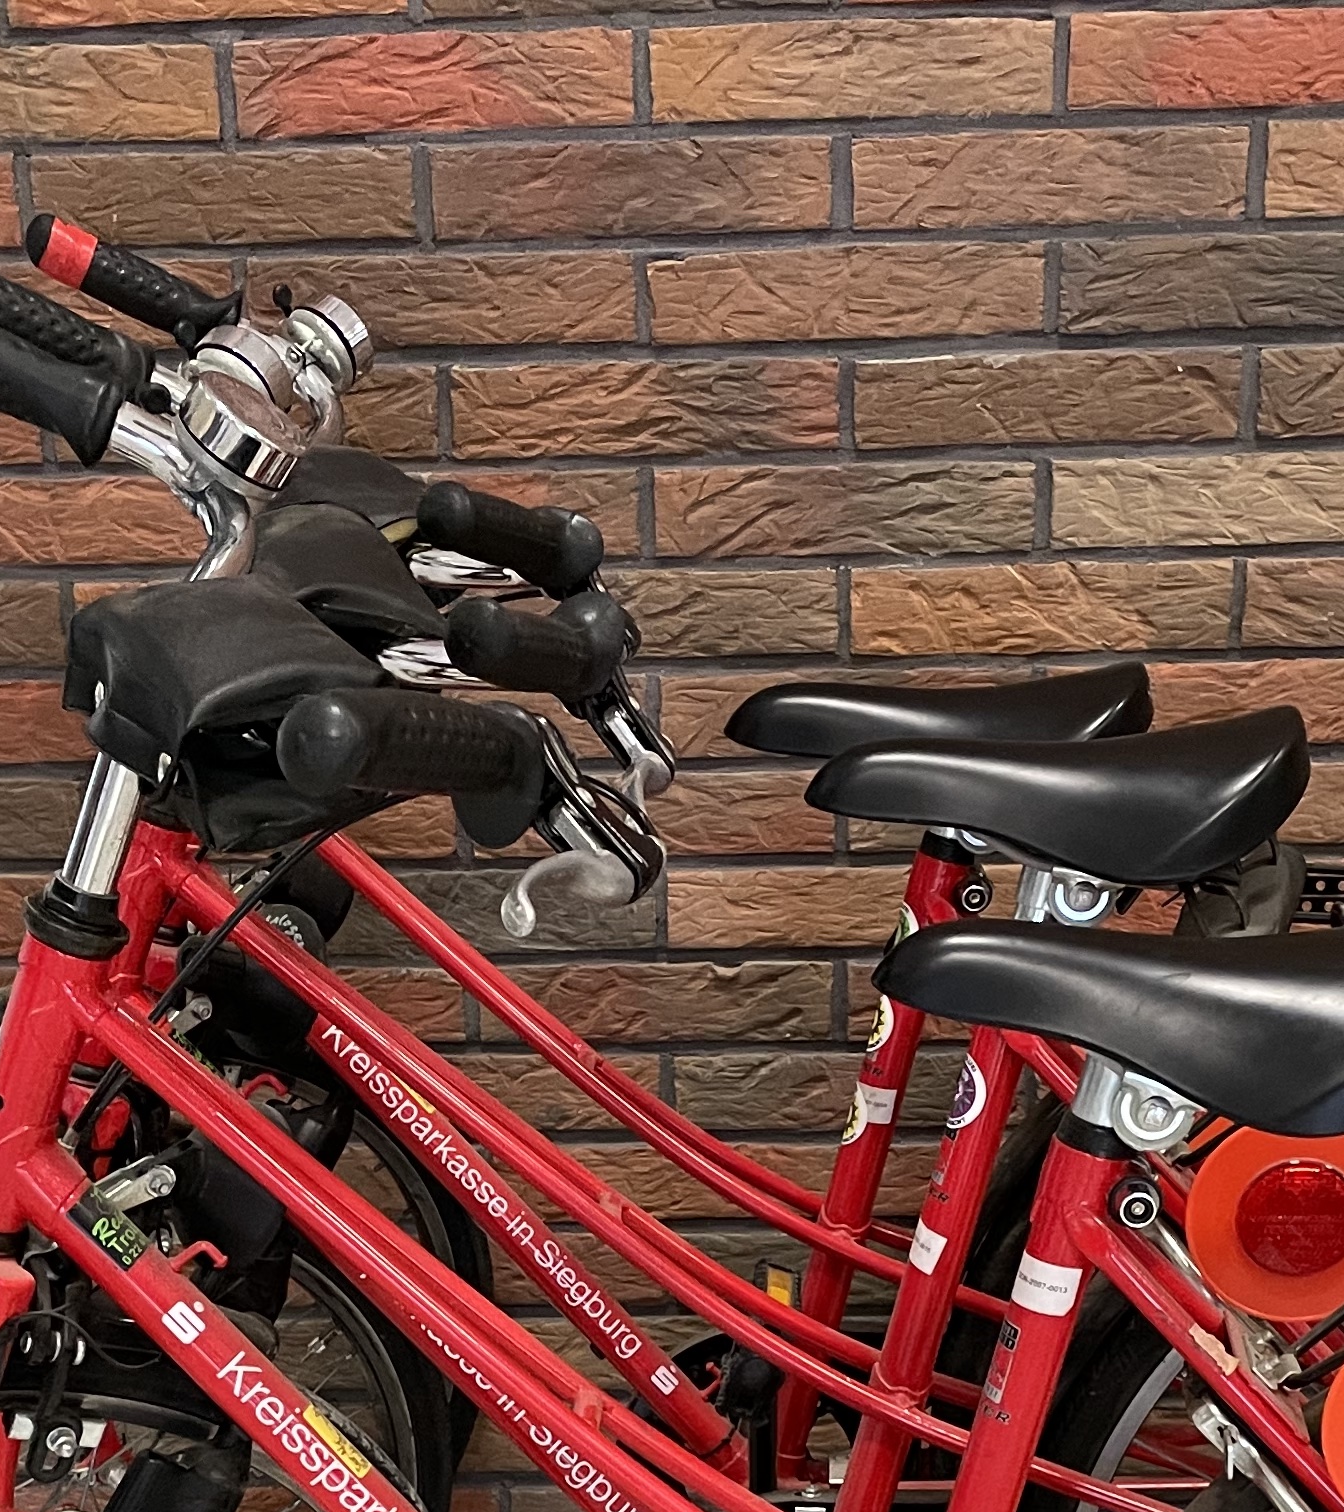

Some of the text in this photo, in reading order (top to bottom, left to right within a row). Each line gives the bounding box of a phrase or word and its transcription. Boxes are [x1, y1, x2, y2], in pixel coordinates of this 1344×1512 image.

[322, 1025, 508, 1217] Kreissparkasse
[506, 1210, 535, 1246] in
[534, 1240, 642, 1359] Siegburg
